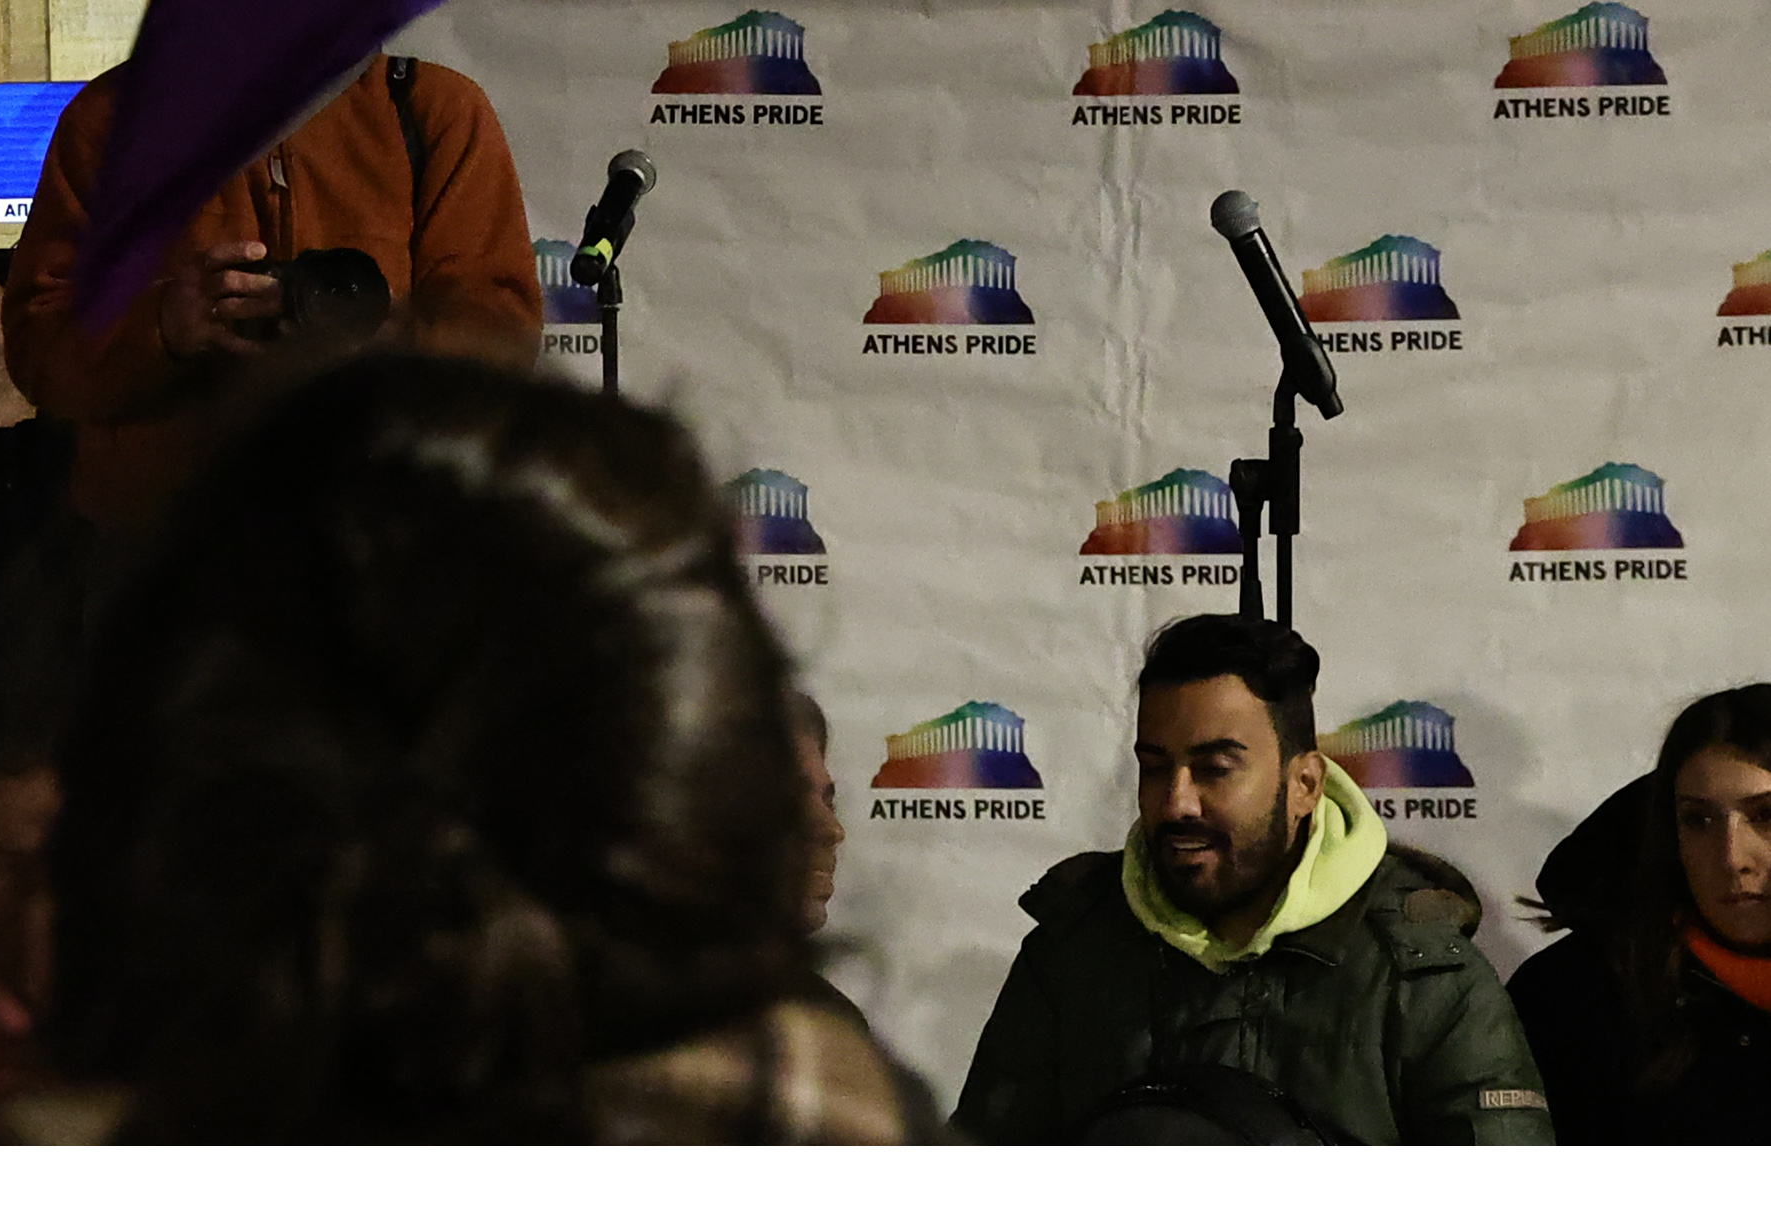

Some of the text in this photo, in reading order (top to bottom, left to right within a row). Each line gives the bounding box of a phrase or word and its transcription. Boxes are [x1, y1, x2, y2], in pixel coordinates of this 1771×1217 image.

[650, 104, 824, 125] ATHENS PRIDE
[1072, 104, 1242, 126] ATHENS PRIDE
[1493, 95, 1671, 120] ATHENS PRIDE
[4, 203, 29, 217] ΑΠ
[544, 334, 604, 355] PRID
[861, 335, 1037, 355] ATHENS PRIDE
[1318, 331, 1463, 352] HENS PRIDE
[1718, 326, 1771, 347] ATH
[758, 565, 829, 586] PRIDE
[1079, 565, 1242, 585] ATHENS PRID
[1509, 559, 1688, 582] ATHENS PRIDE
[870, 799, 1046, 820] ATHENS PRIDE
[1405, 798, 1477, 820] PRIDE
